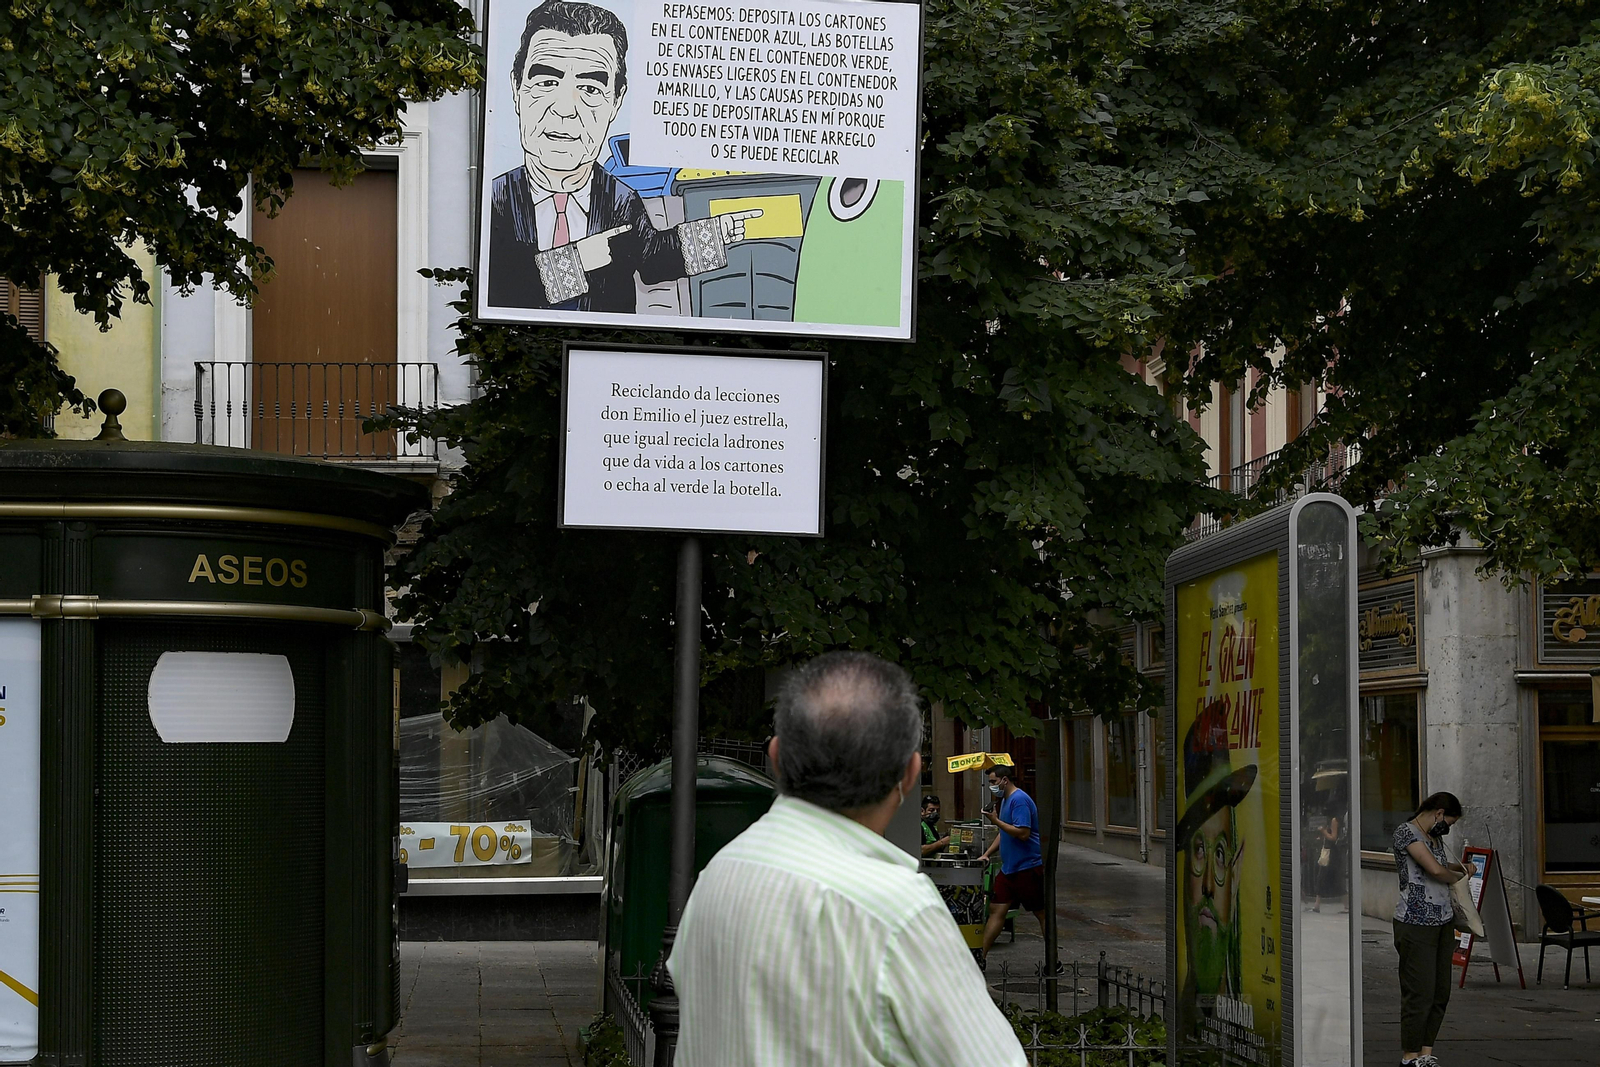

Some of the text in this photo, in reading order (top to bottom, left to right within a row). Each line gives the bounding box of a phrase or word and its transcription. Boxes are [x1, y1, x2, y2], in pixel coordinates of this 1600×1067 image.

[664, 4, 886, 31] REPASEMOS: DEPOSITA LOS CARTONES
[652, 23, 893, 51] EN EL CONTENEDOR AZUL, LAS BOTELLAS
[659, 42, 892, 72] DE CRISTAL EN EL CONTENEDOR VERDE,
[647, 62, 898, 90] LOS ENVASES LIGEROS EN EL CONTENEDOR
[658, 81, 883, 108] AMARILLO, Y LAS CAUSAS PERDIDAS NO
[654, 101, 689, 116] DEJES
[694, 103, 708, 117] DE
[713, 104, 798, 122] DEPOSITARLAS
[802, 110, 817, 124] EN
[839, 112, 885, 130] PORQUE
[664, 121, 875, 147] TODO EN ESTA VIDA TIENE ARREGLO
[711, 144, 839, 165] O SE PUEDE RECICLAR
[612, 383, 779, 403] Reciclando da lecciones
[601, 406, 787, 429] don Emilio el juez estrella,
[604, 431, 784, 450] que igual recicla ladrones
[603, 454, 783, 473] que da vida a los cartones
[604, 477, 781, 496] o echa al verde la botella.
[188, 554, 308, 588] ASEOS
[1198, 618, 1257, 687] EL GRAN
[960, 756, 981, 766] ONCE
[450, 825, 522, 862] 70%
[1217, 995, 1254, 1030] GRANADA
